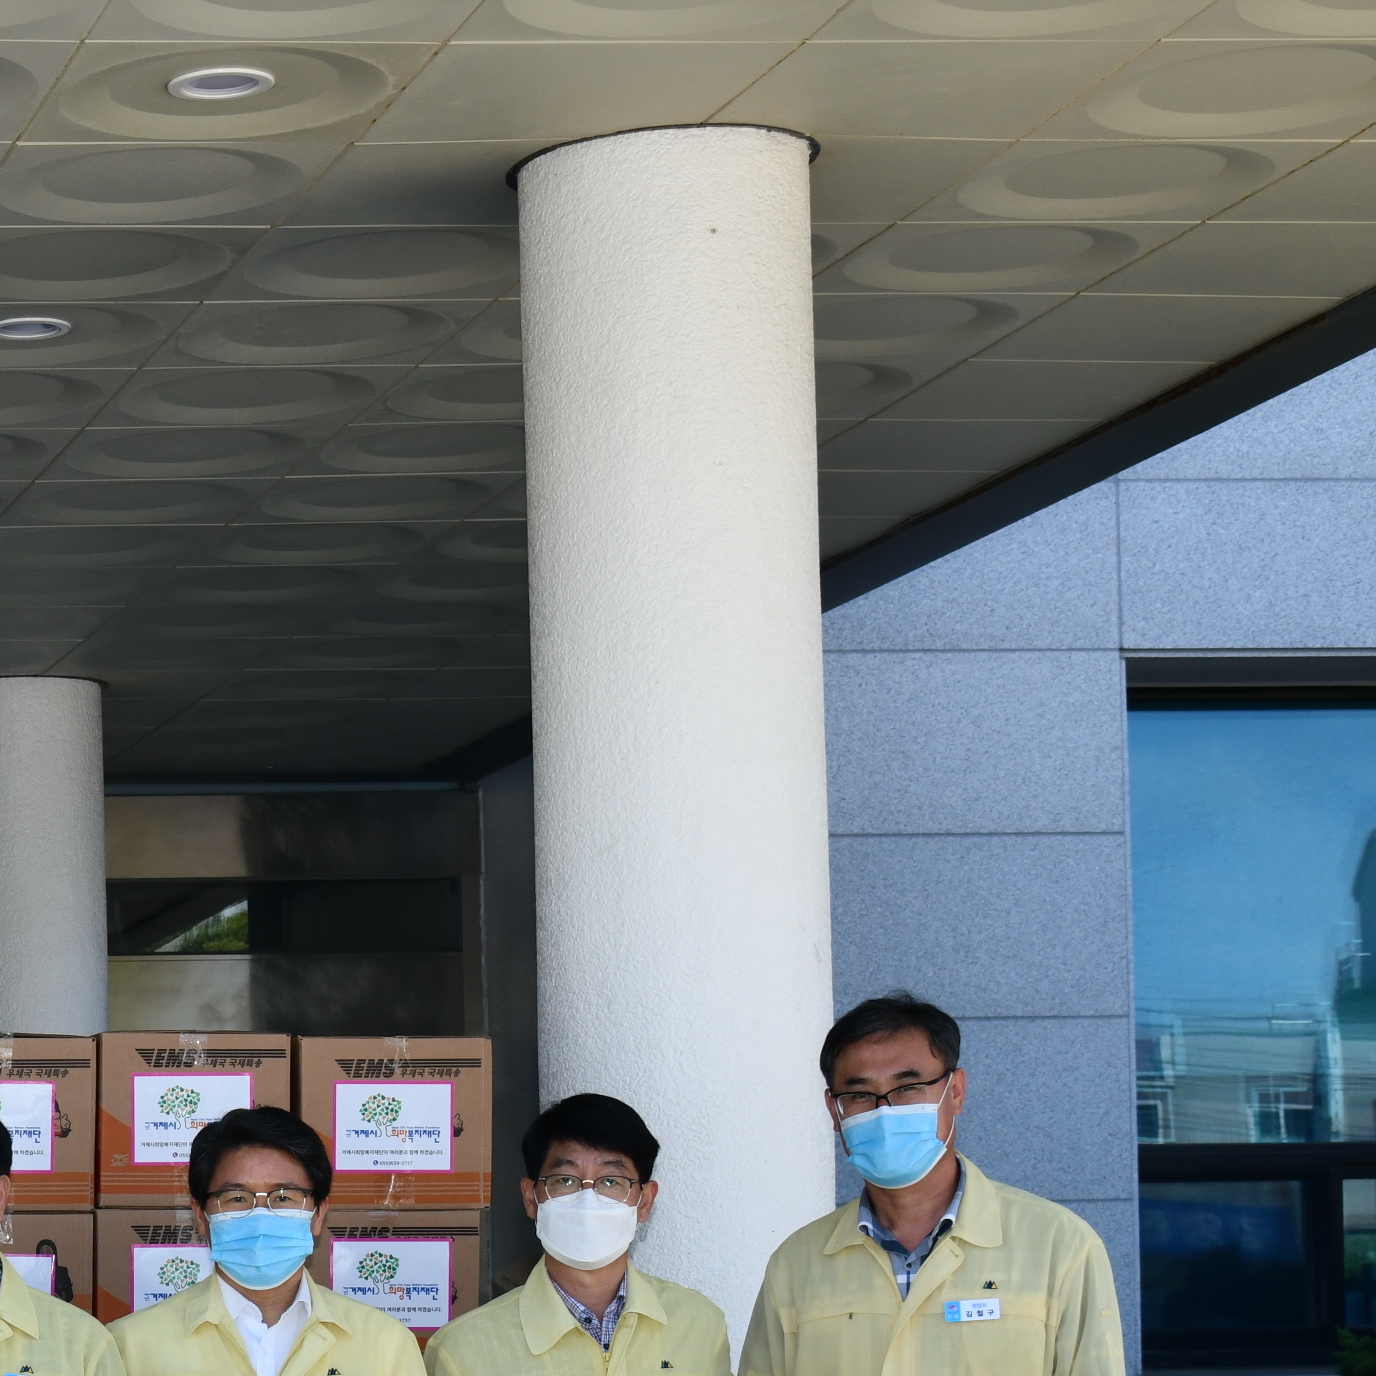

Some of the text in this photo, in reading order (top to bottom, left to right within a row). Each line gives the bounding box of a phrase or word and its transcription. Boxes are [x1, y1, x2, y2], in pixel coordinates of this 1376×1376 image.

[229, 1059, 262, 1068] 국제특송
[35, 1069, 69, 1078] 국제특송
[428, 1069, 461, 1078] 국제특송
[152, 1122, 178, 1132] 거제시
[9, 1130, 41, 1144] 복지재단
[352, 1129, 440, 1143] 거제시 희망복지재단
[150, 1226, 193, 1244] EMS
[348, 1286, 439, 1301] 거제시 희망복지재단
